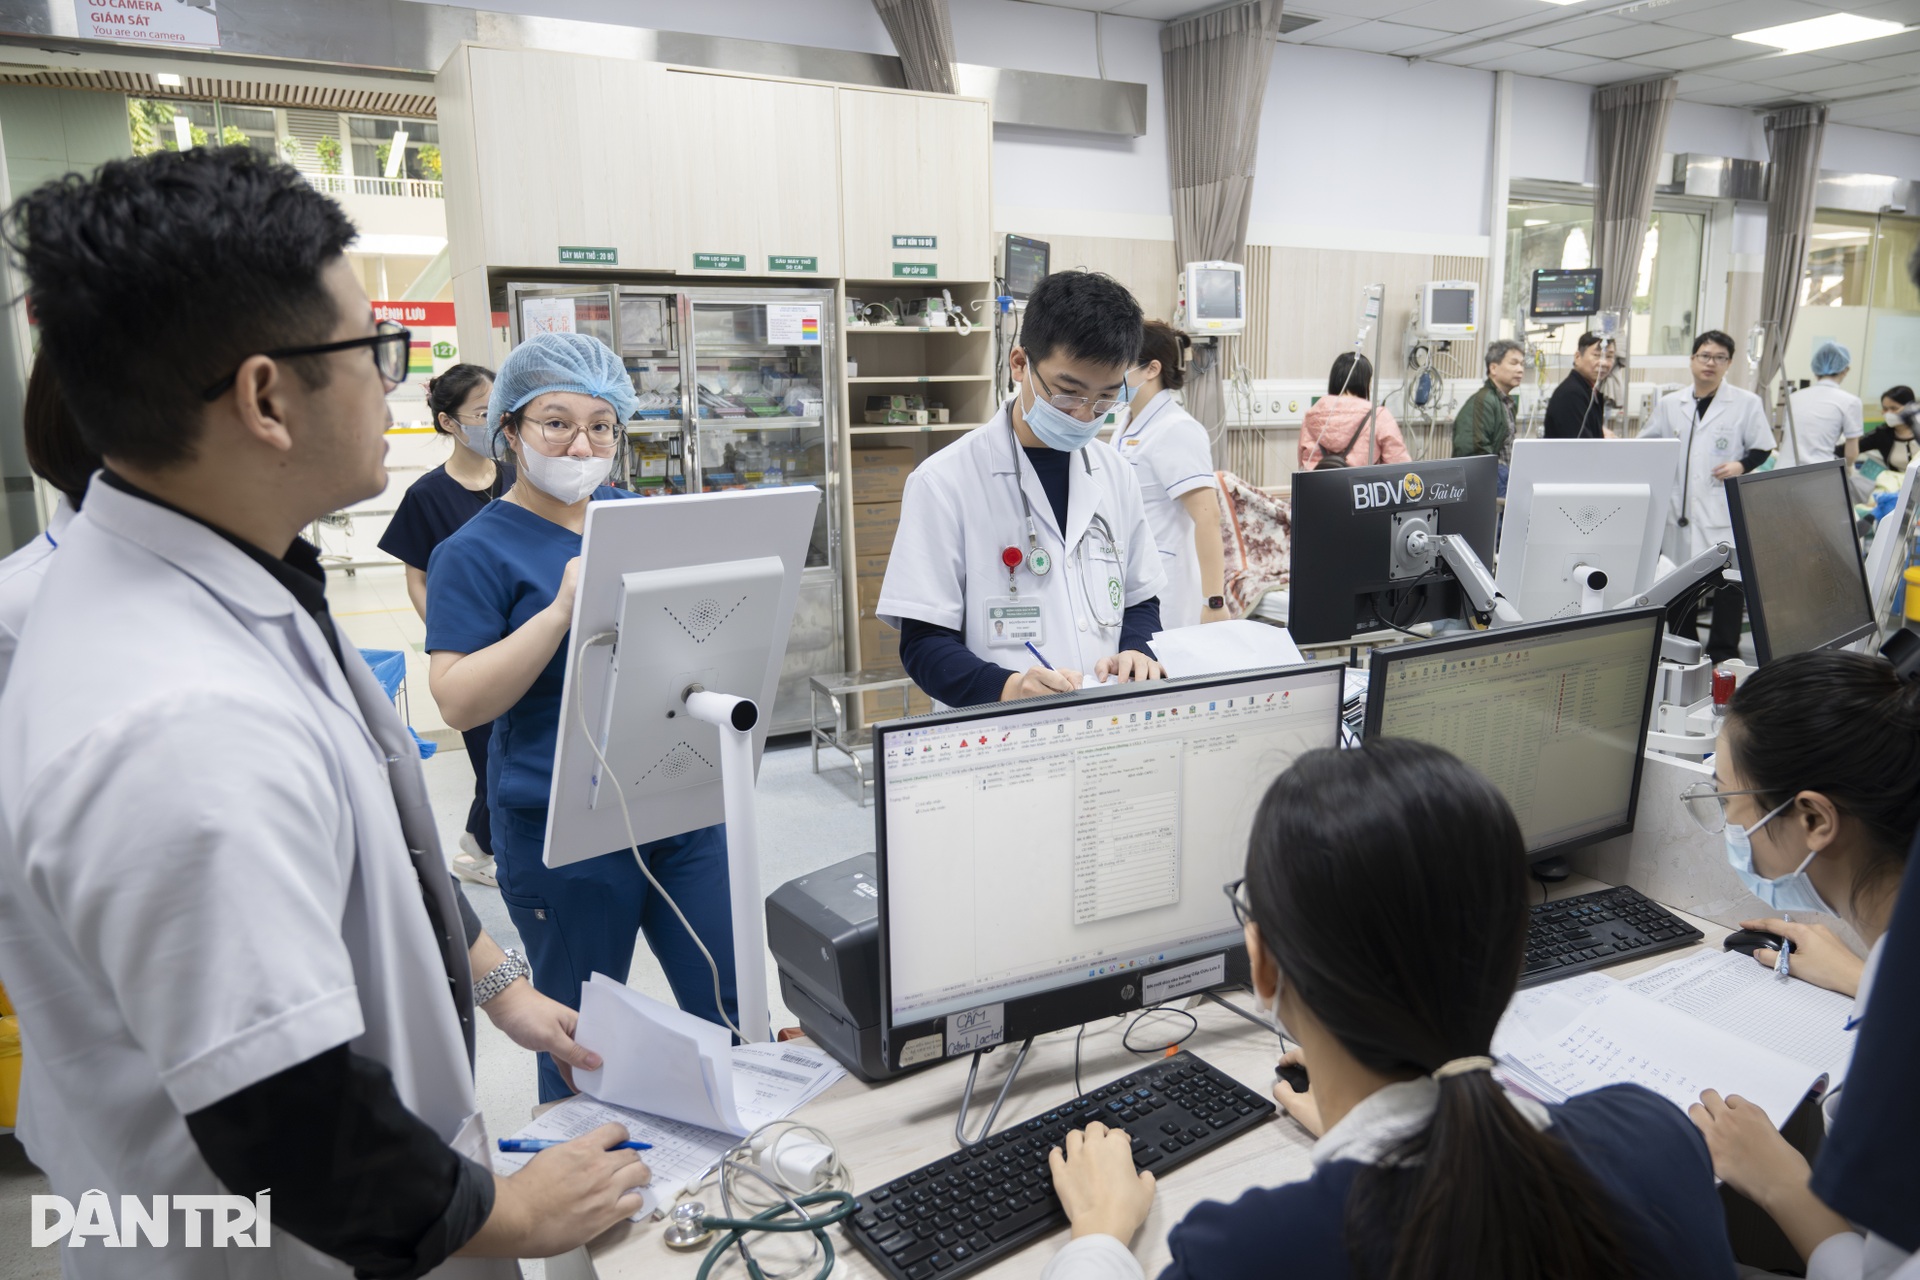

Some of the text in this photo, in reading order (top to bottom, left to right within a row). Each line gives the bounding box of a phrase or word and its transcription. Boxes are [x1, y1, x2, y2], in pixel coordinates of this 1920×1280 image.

[109, 0, 162, 12] CAMERA
[91, 10, 150, 26] GIÁM SÁT
[93, 25, 112, 36] You
[115, 28, 130, 37] are
[149, 31, 185, 41] camera
[434, 346, 454, 356] 127
[1353, 480, 1404, 510] BIDV
[975, 1026, 1002, 1048] Lactat
